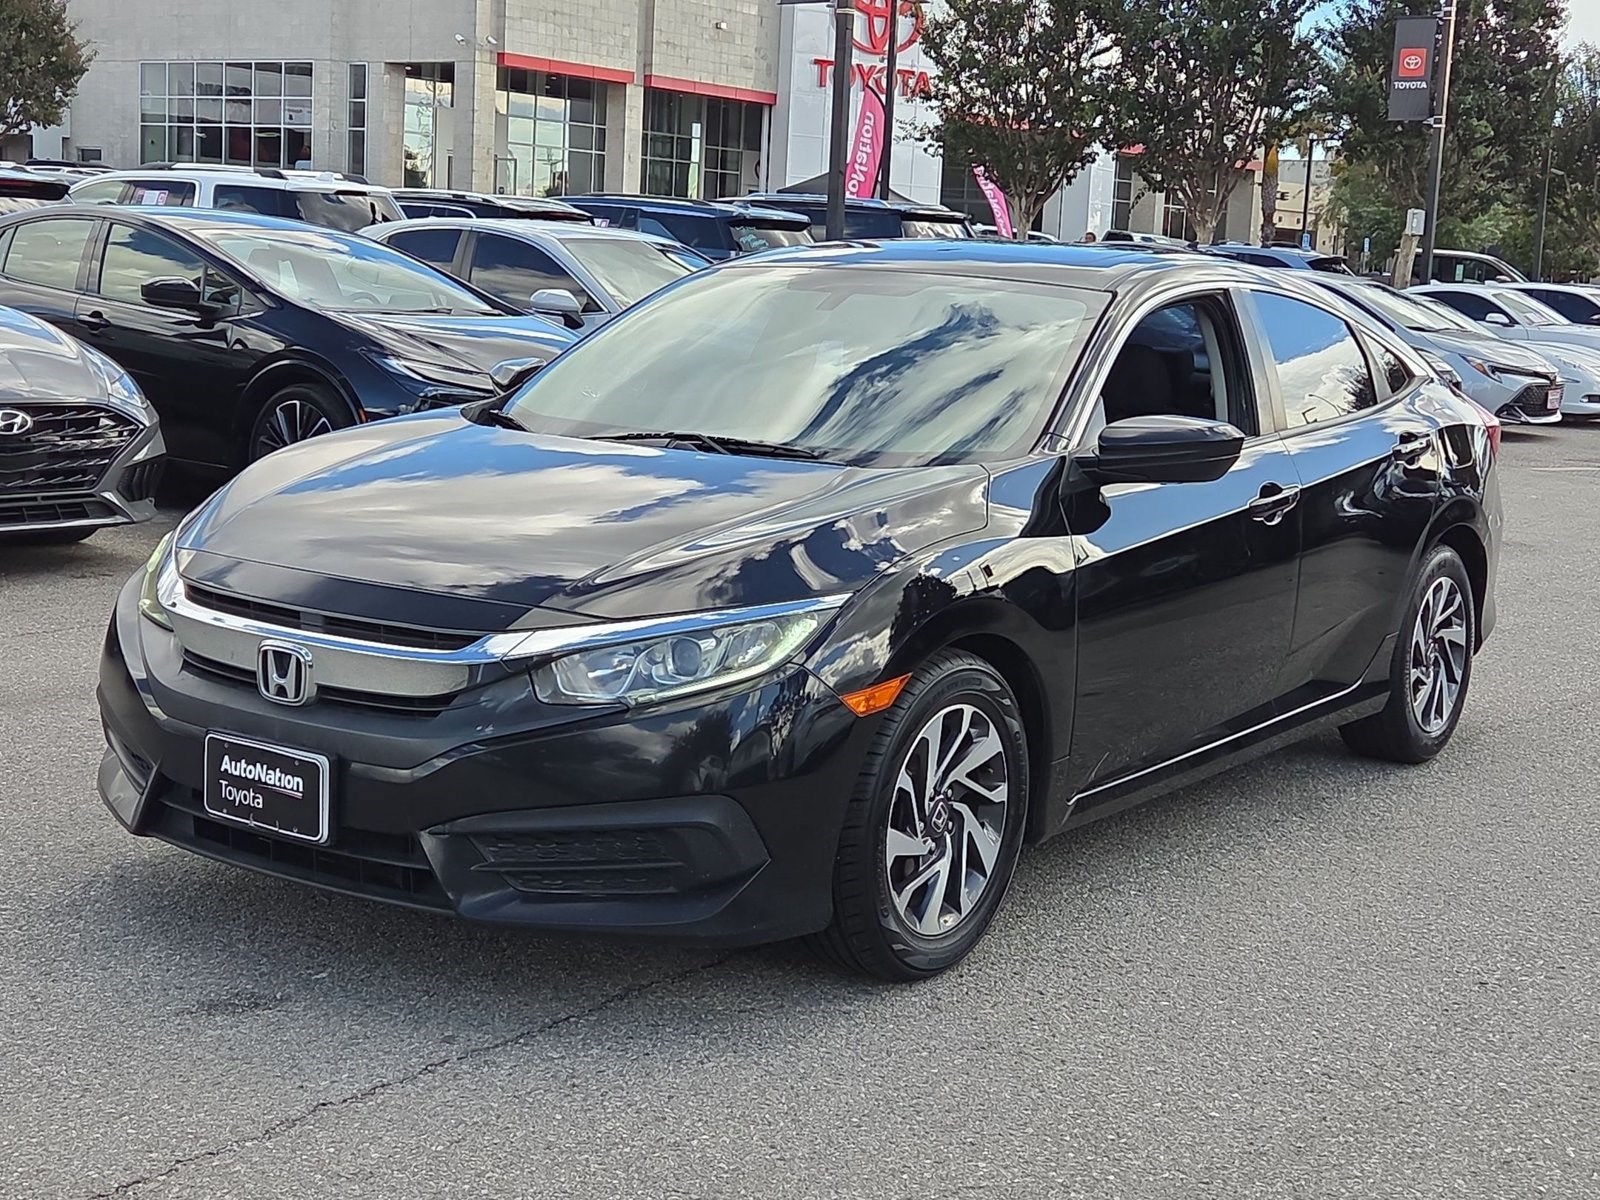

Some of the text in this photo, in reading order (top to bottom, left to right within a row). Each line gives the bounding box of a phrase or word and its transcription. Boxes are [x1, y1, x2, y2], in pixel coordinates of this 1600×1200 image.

[1393, 81, 1428, 90] TOYOTA
[220, 754, 304, 792] AutoNation
[219, 779, 264, 810] Toyota
